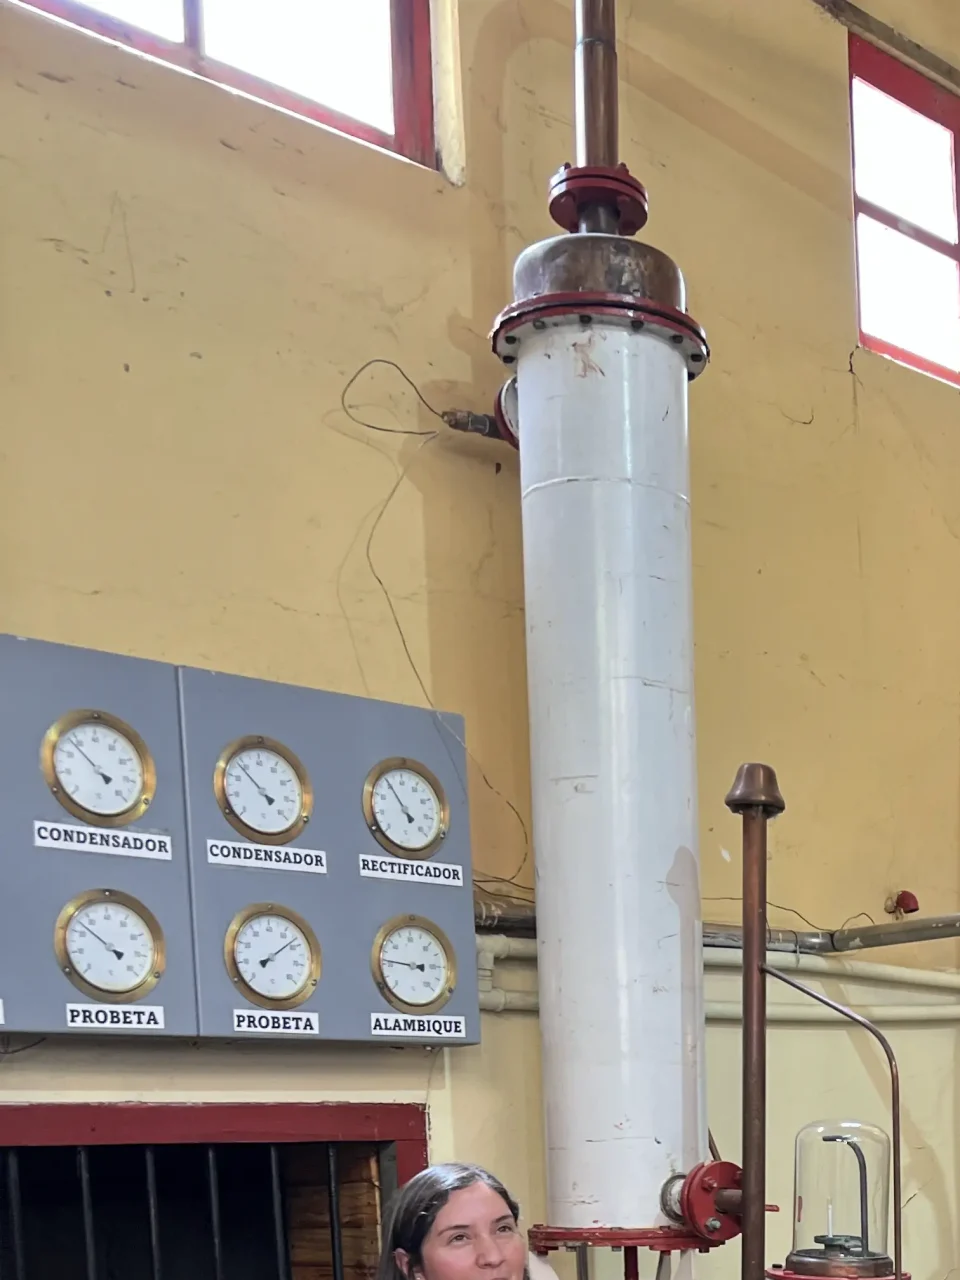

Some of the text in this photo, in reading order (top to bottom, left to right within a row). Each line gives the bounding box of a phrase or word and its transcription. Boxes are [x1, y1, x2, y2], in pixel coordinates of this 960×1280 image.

[37, 826, 168, 853] CONDENSADOR
[209, 844, 324, 867] CONDENSADOR
[361, 859, 460, 880] RECTIFICADOR
[69, 1009, 159, 1025] PROBETA
[236, 1014, 314, 1031] PROBETA
[373, 1018, 462, 1035] ALAMBIQUE
